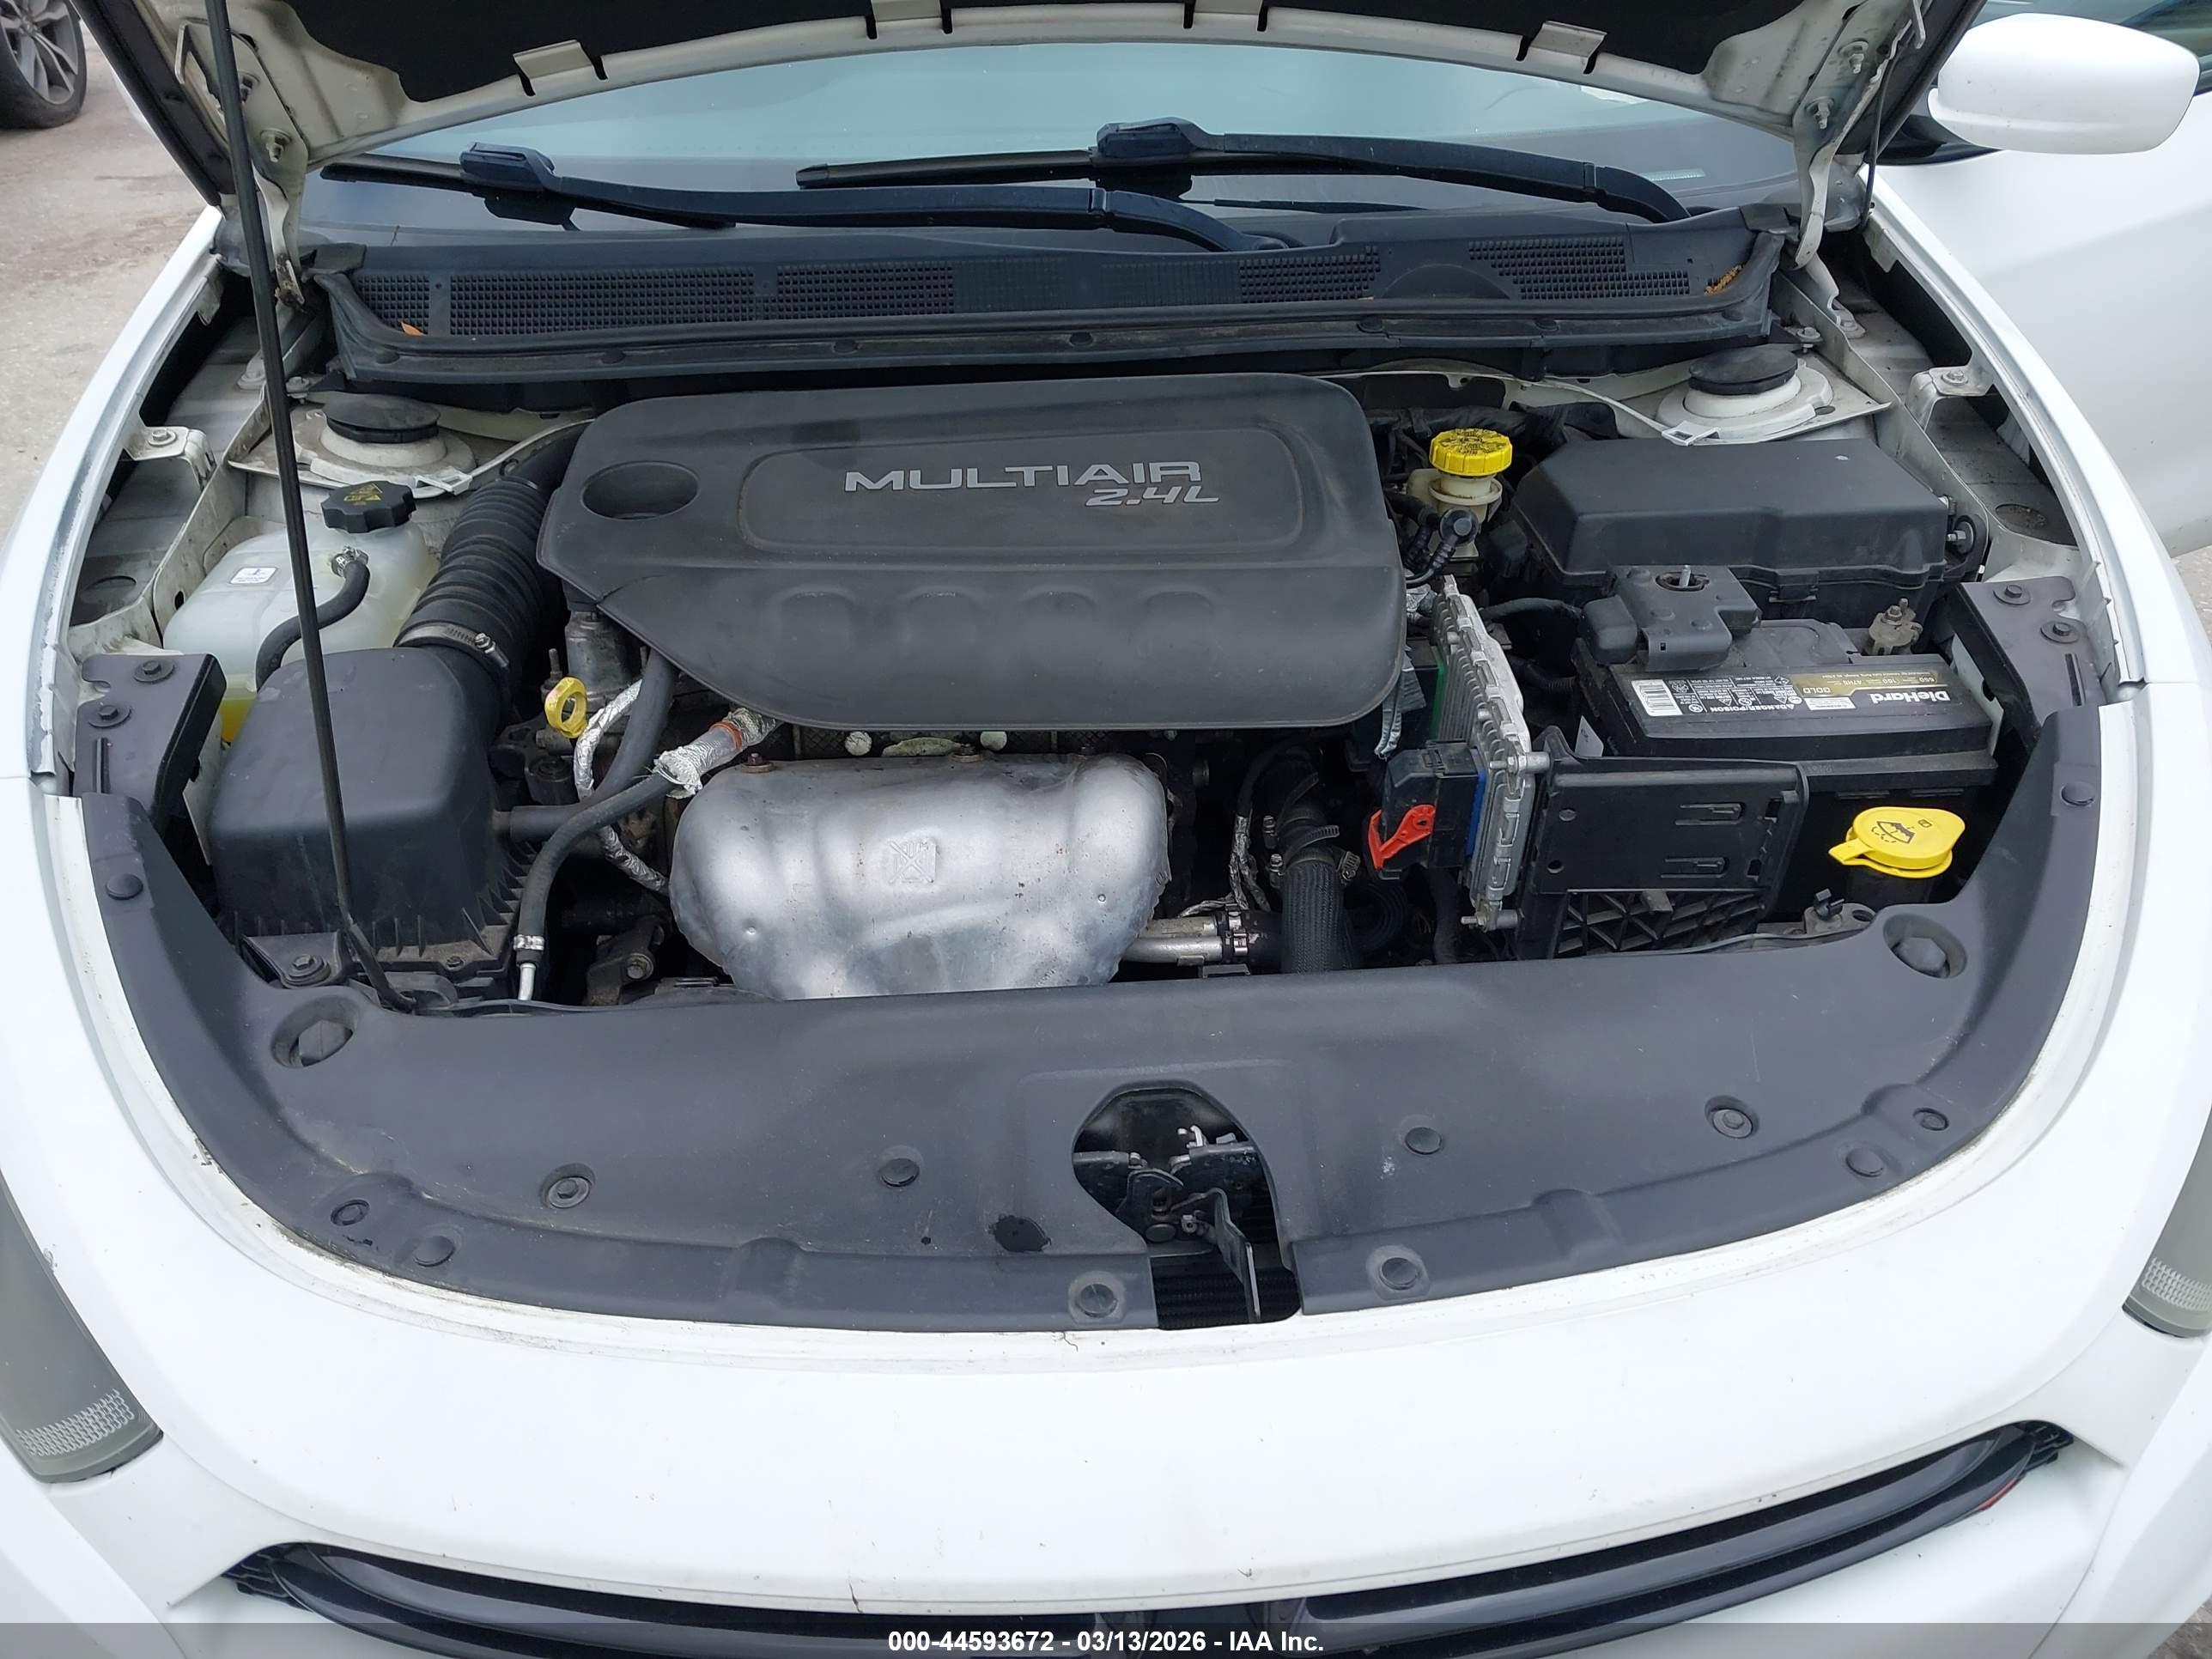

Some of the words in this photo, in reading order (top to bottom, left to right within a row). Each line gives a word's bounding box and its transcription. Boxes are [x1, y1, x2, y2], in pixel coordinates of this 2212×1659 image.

[843, 460, 1201, 493] MULTIAIR
[1085, 485, 1219, 507] 2.4L
[1869, 690, 1951, 704] DieHard
